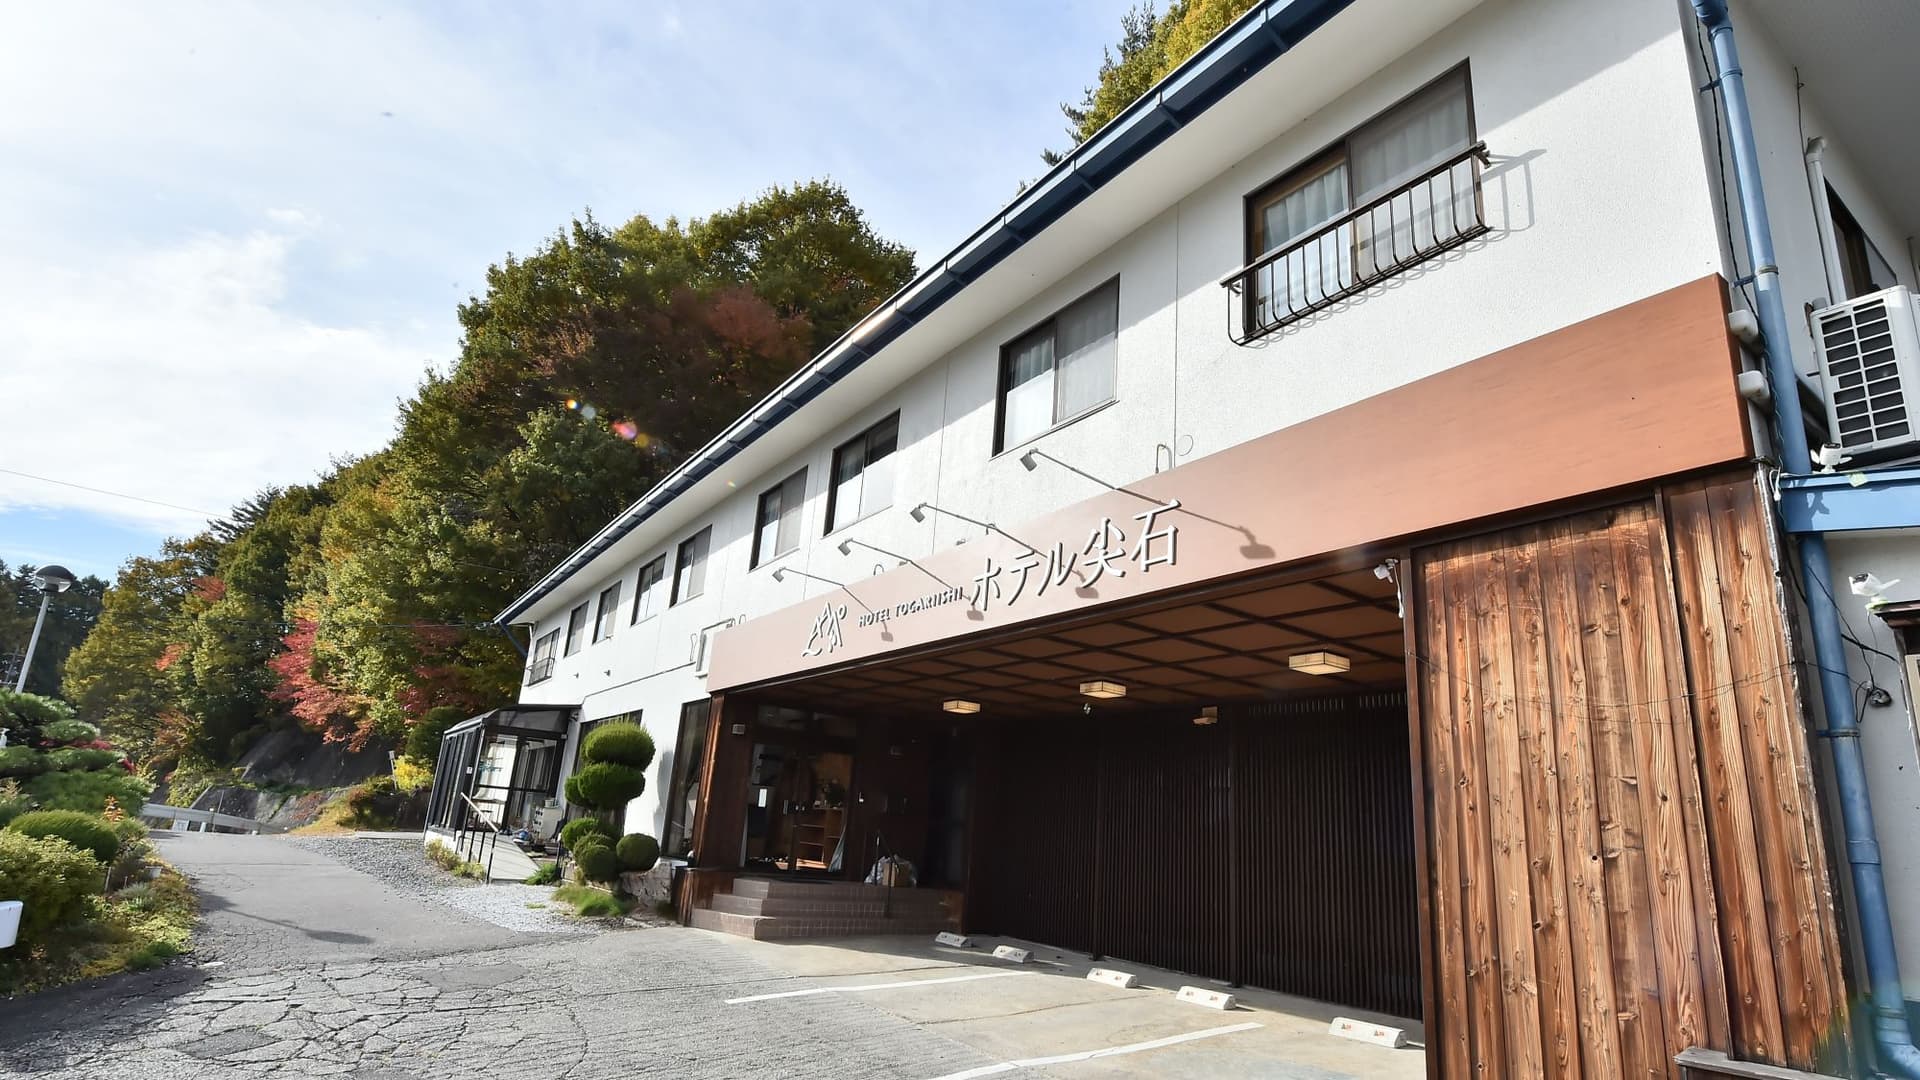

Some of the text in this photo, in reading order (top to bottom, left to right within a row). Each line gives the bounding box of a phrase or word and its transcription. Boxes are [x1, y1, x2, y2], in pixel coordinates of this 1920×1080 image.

[970, 498, 1181, 612] ホテル尖石
[858, 608, 891, 628] HOTEL
